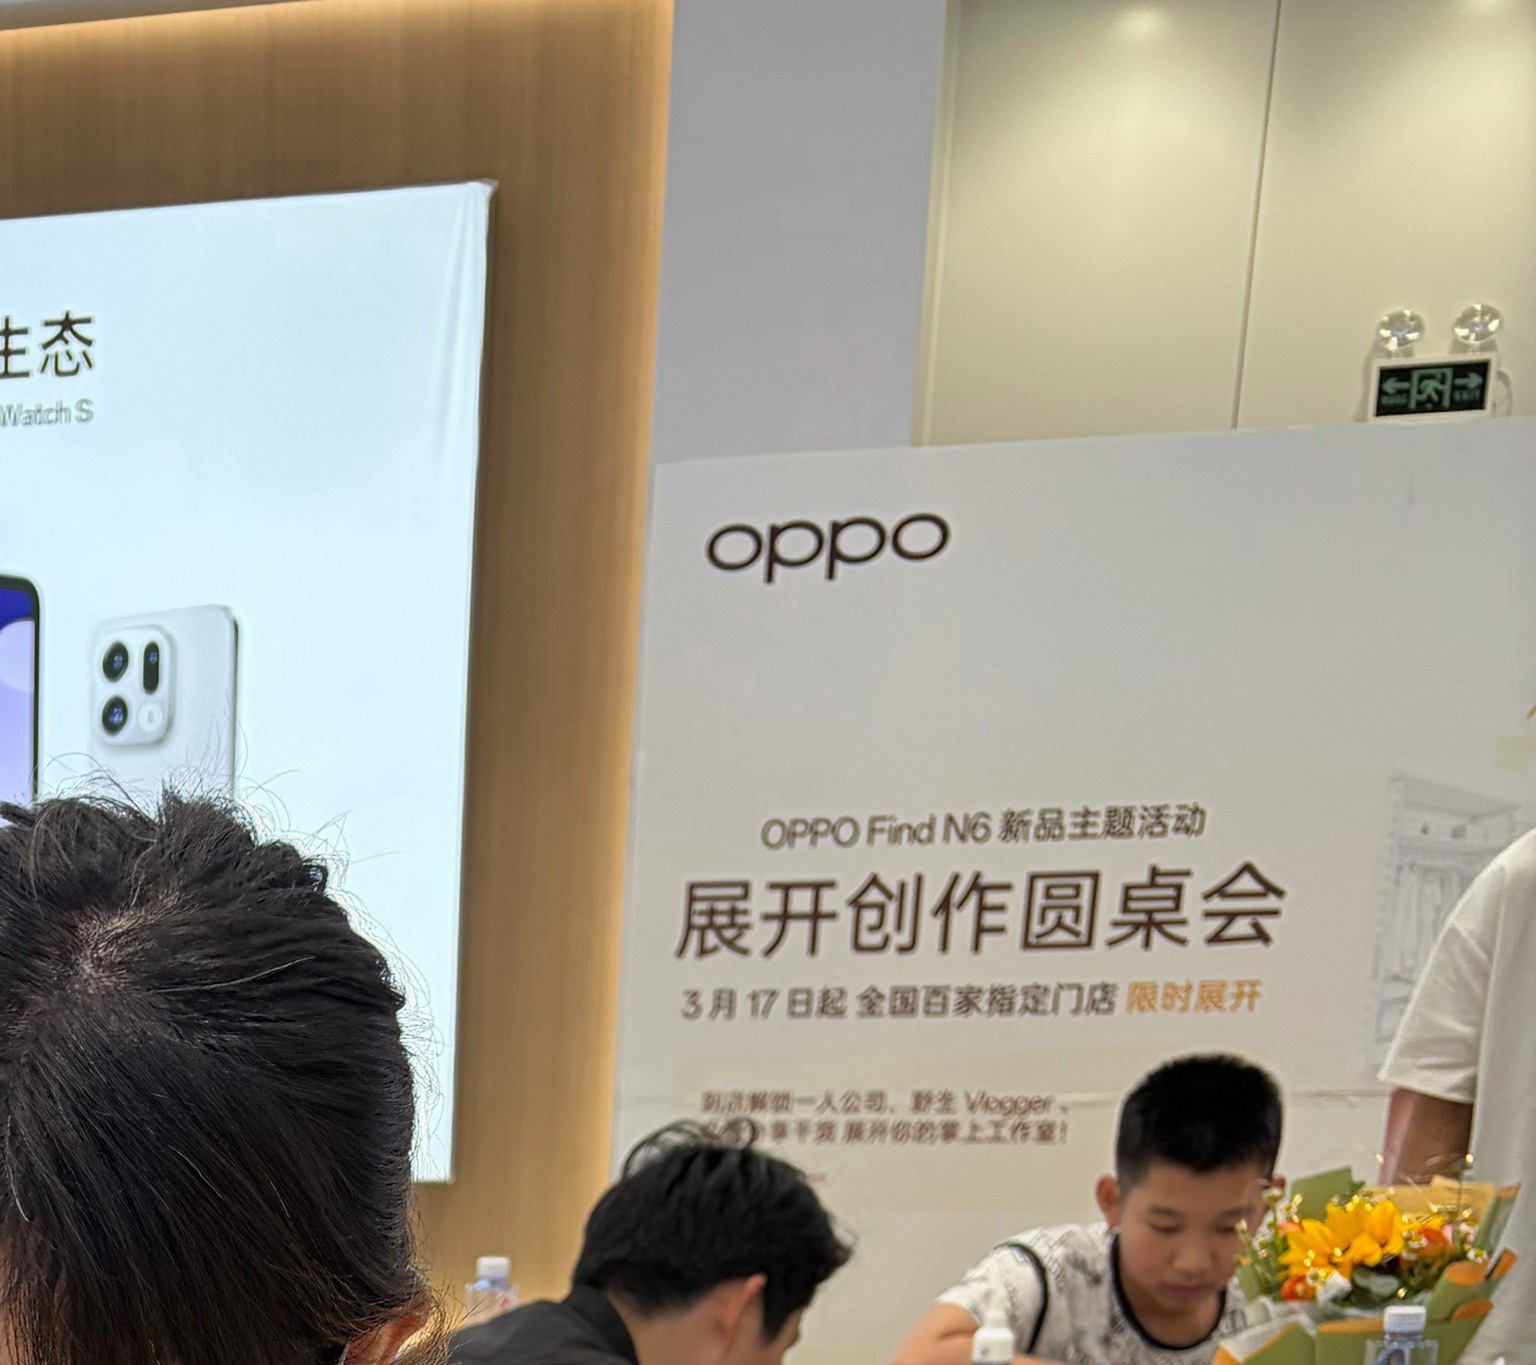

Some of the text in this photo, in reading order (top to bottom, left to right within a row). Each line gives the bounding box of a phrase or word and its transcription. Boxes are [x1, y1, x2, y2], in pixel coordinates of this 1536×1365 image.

[75, 398, 96, 424] S
[706, 512, 952, 585] oppo
[760, 803, 1207, 850] OPPO Find N6 新品主题活动
[674, 861, 1288, 960] 展开创作圆桌会
[855, 982, 1119, 1019] 全国百家指定门店
[1126, 979, 1262, 1014] 限时展开
